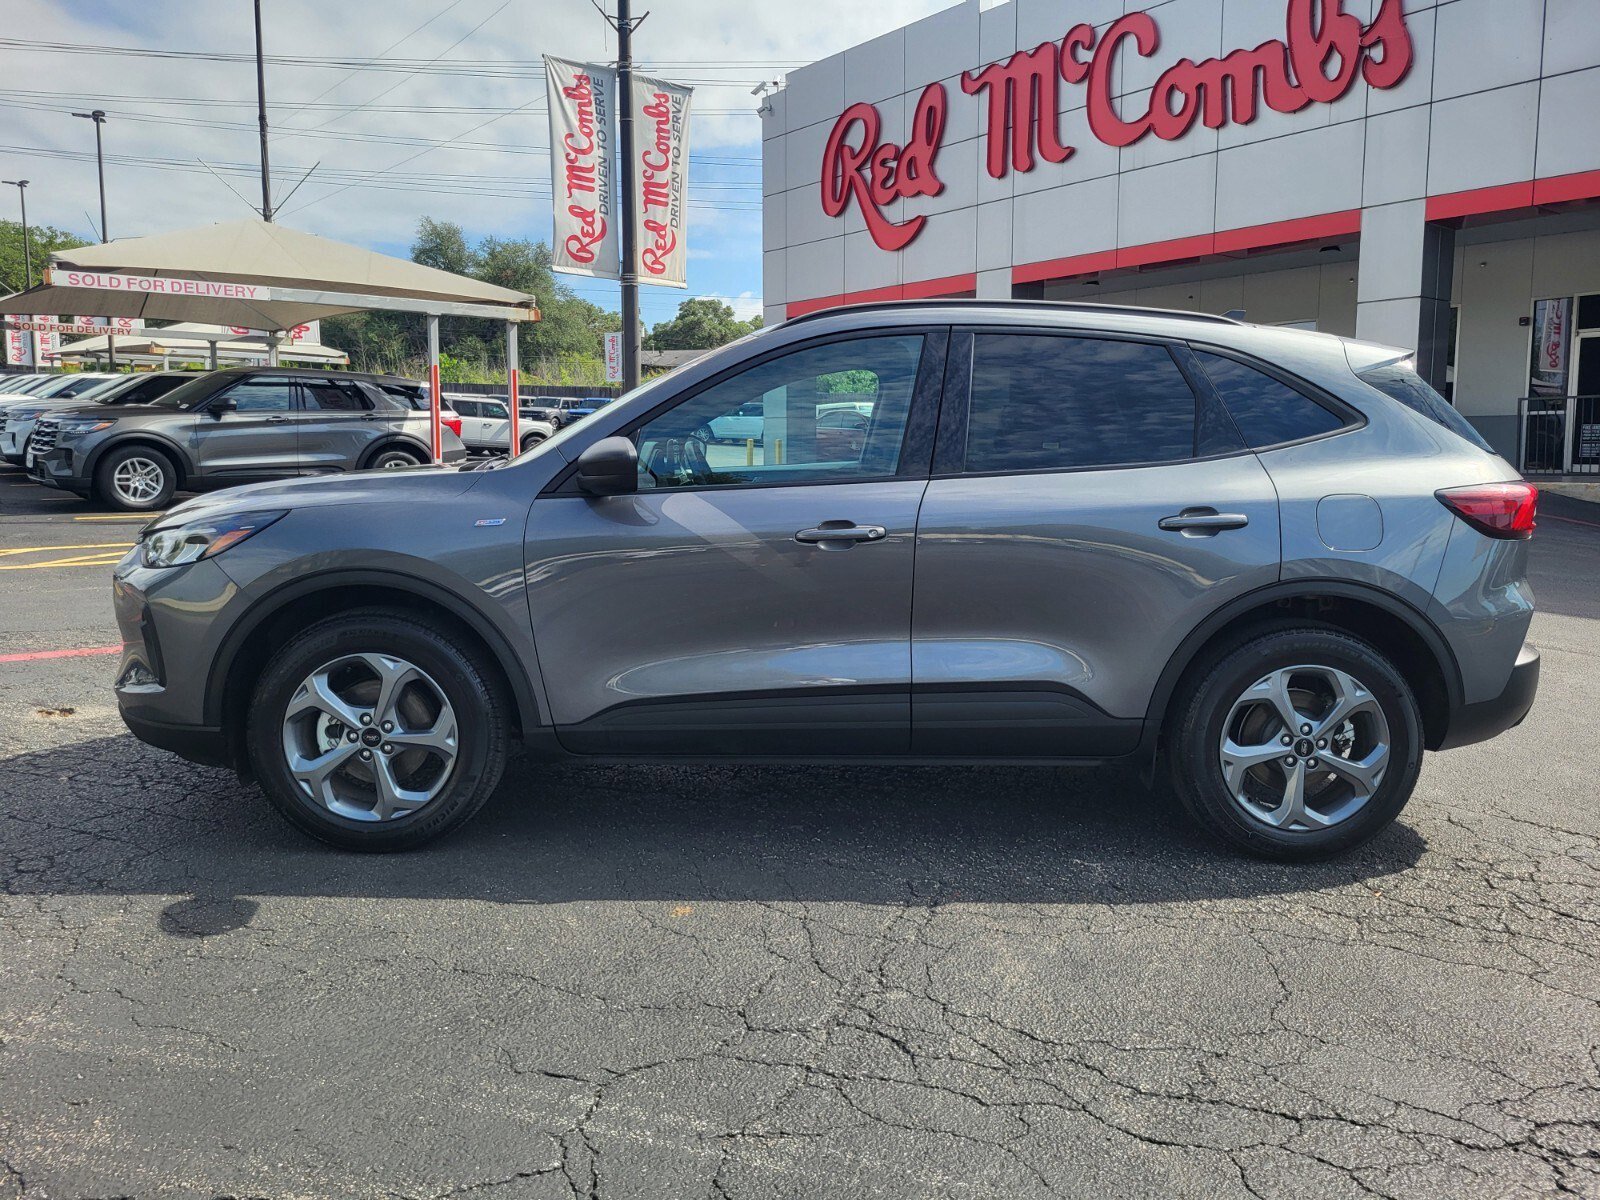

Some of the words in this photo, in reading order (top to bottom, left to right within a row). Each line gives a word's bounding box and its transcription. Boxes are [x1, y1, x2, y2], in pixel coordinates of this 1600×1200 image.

[595, 77, 605, 126] SERVE
[670, 95, 682, 144] SERVE
[822, 83, 945, 251] Red
[962, 0, 1414, 178] McCombs
[563, 73, 595, 199] McCombs
[597, 131, 607, 152] TO
[642, 93, 670, 213] McCombs
[671, 148, 681, 169] TO
[599, 155, 610, 216] DRIVEN
[670, 174, 681, 229] DRIVEN
[566, 204, 607, 264] Red
[642, 219, 676, 275] Red
[68, 273, 122, 288] SOLD
[127, 277, 165, 292] FOR
[171, 281, 257, 298] DELIVERY
[12, 346, 26, 362] Red
[14, 322, 46, 331] SOLD
[50, 324, 74, 333] FOR
[77, 326, 131, 335] DELIVERY
